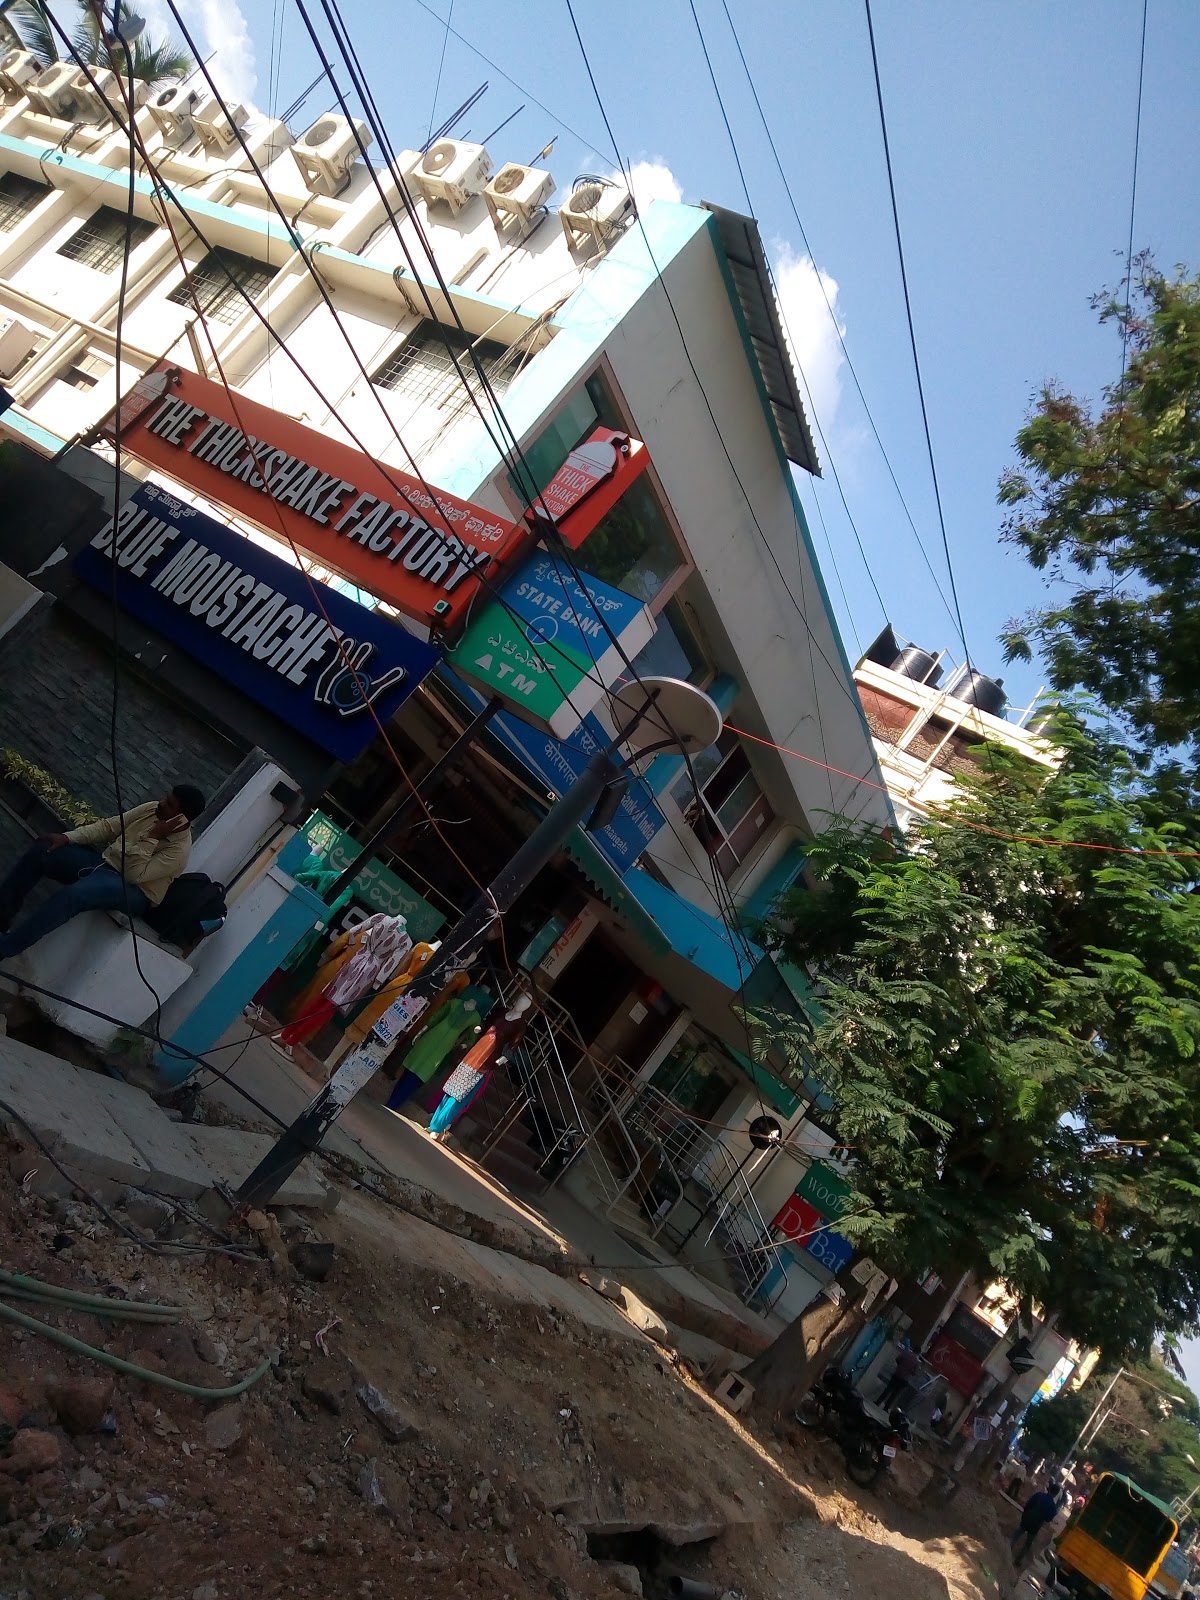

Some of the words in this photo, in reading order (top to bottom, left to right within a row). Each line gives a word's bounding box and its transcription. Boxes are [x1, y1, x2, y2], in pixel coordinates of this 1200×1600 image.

[556, 467, 595, 493] THICK
[578, 463, 591, 472] THE
[144, 394, 205, 445] THE
[187, 416, 353, 524] THICKSHAKE
[334, 494, 489, 591] FACTORY
[546, 484, 579, 505] SHAKE
[542, 497, 568, 515] FACTORY
[89, 503, 181, 577] BLUE
[150, 538, 344, 685] MOUSTACHE
[515, 582, 560, 614] STATE
[560, 602, 604, 638] BANK
[474, 653, 539, 696] ATM
[632, 810, 645, 823] of
[638, 815, 655, 840] India
[605, 824, 629, 855] mangala
